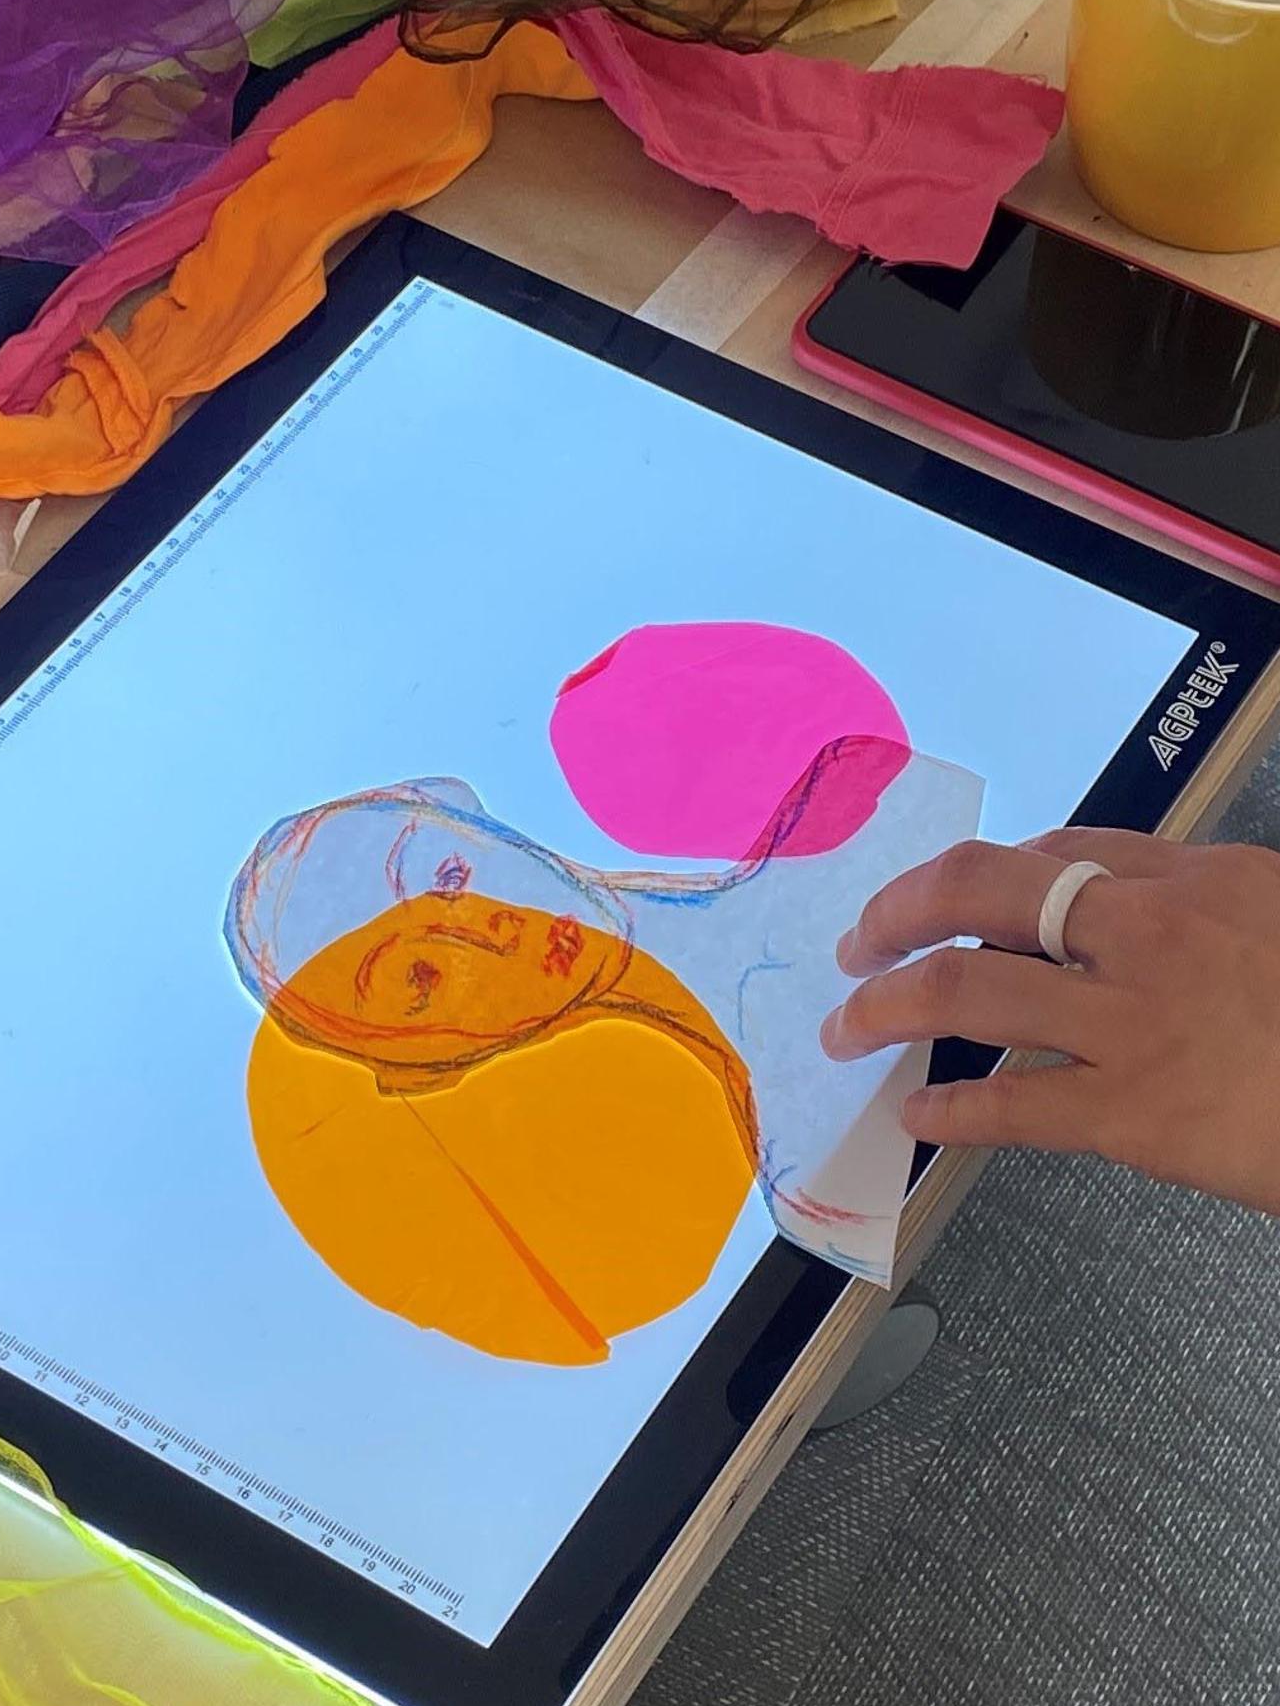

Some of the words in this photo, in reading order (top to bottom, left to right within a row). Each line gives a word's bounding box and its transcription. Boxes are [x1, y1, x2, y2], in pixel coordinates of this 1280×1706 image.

[34, 1370, 49, 1383] 11
[73, 1393, 90, 1407] 12
[114, 1416, 130, 1430] 13
[153, 1438, 168, 1452] 14
[194, 1461, 212, 1476] 15
[236, 1486, 252, 1500] 16
[278, 1509, 294, 1523] 17
[319, 1533, 335, 1548] 18
[360, 1557, 377, 1572] 19
[397, 1580, 417, 1595] 20
[441, 1605, 459, 1620] 21
